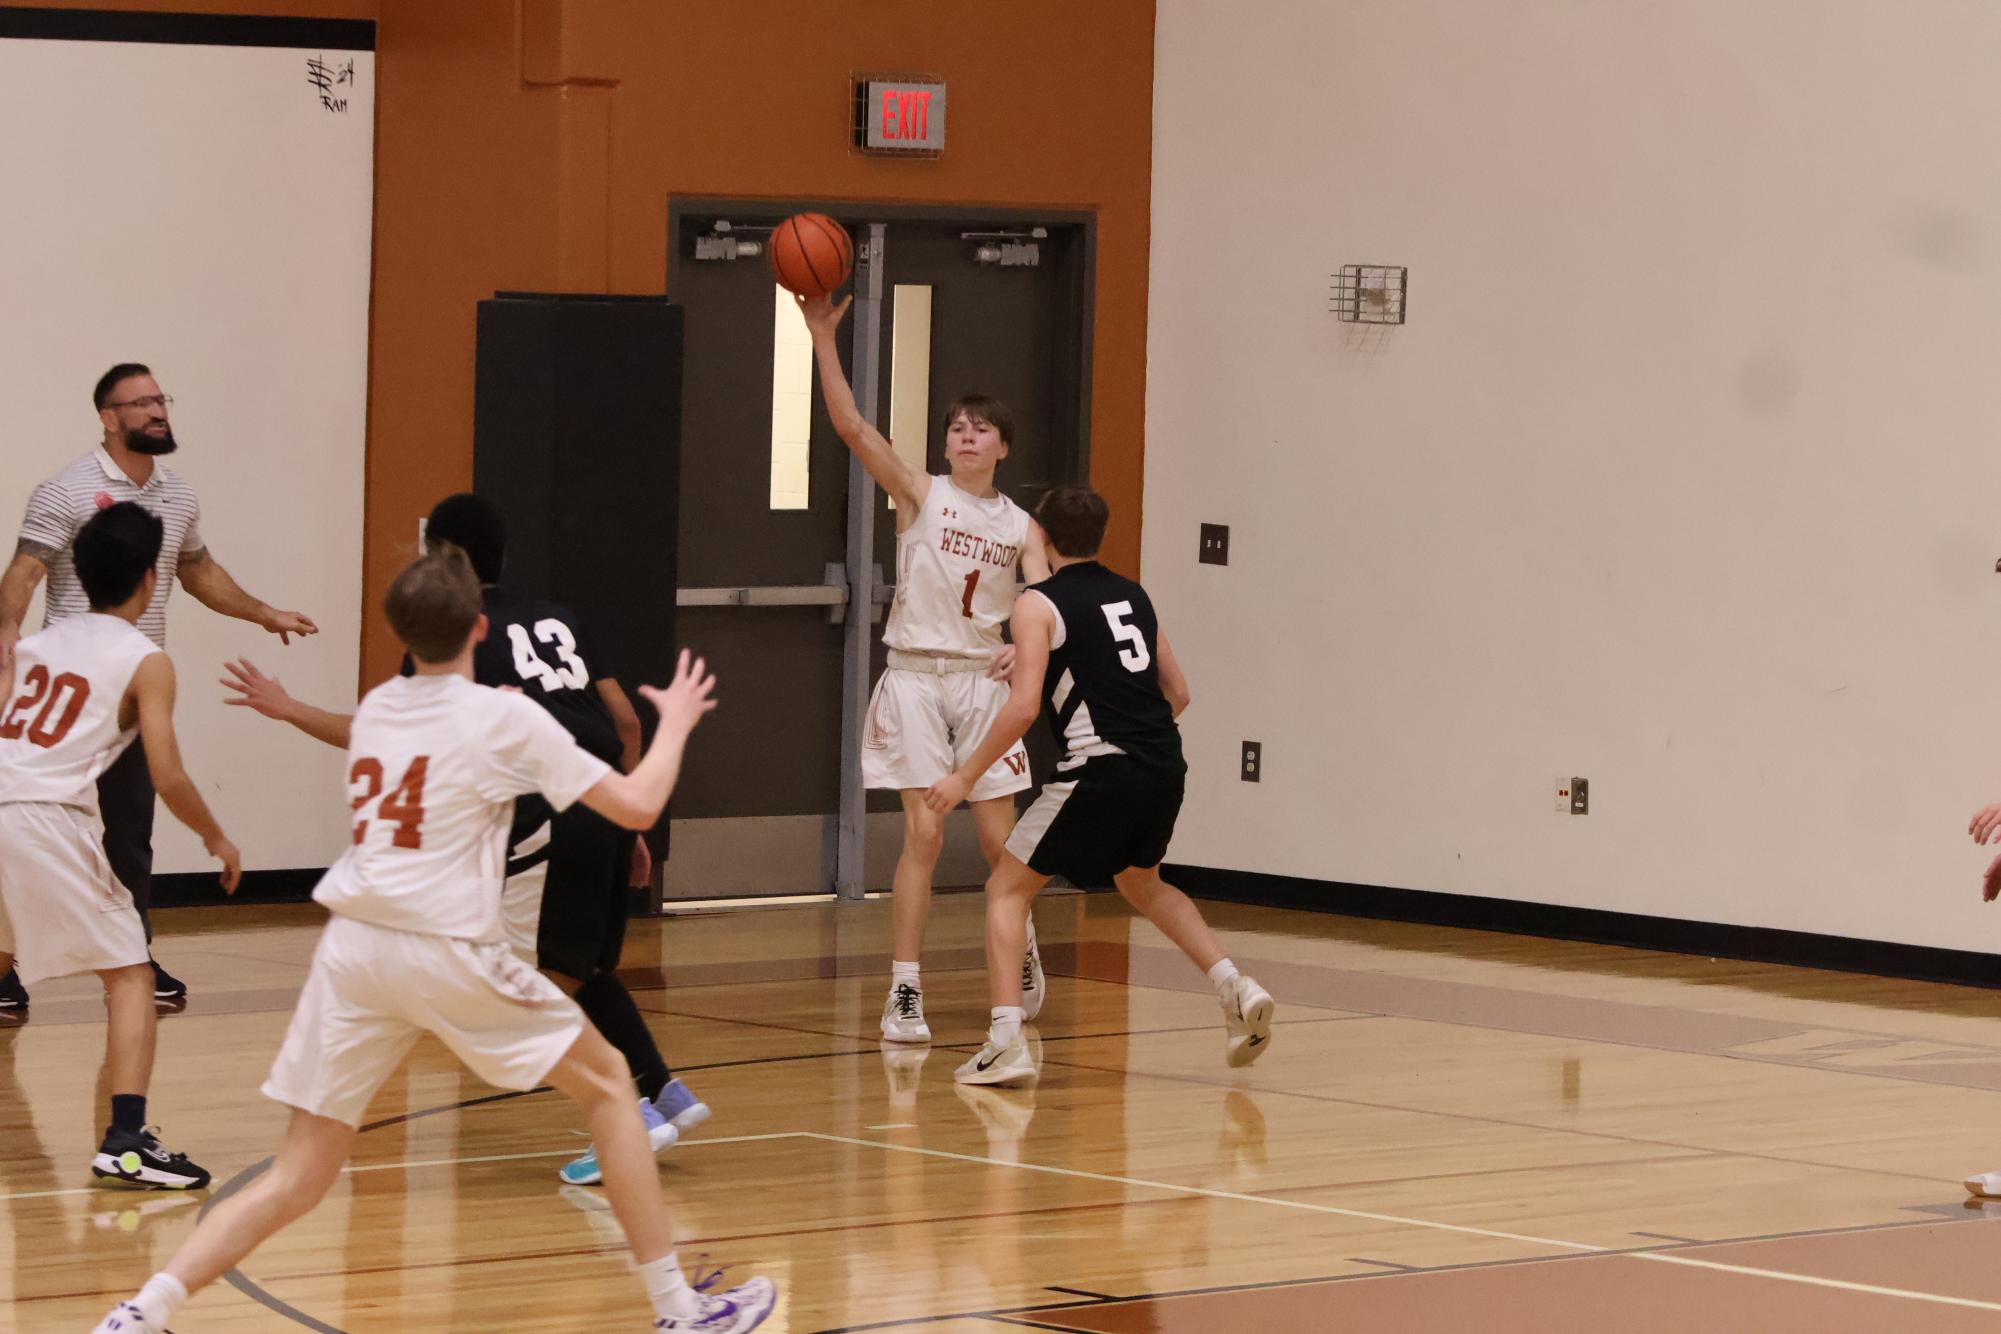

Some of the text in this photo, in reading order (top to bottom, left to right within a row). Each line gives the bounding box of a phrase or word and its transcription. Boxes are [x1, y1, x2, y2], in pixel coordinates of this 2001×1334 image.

[882, 91, 932, 140] EXIT
[961, 569, 981, 620] 1
[507, 618, 590, 692] 43
[1100, 600, 1151, 673] 5
[0, 664, 90, 749] 20
[1003, 750, 1026, 776] W
[350, 755, 430, 850] 24
